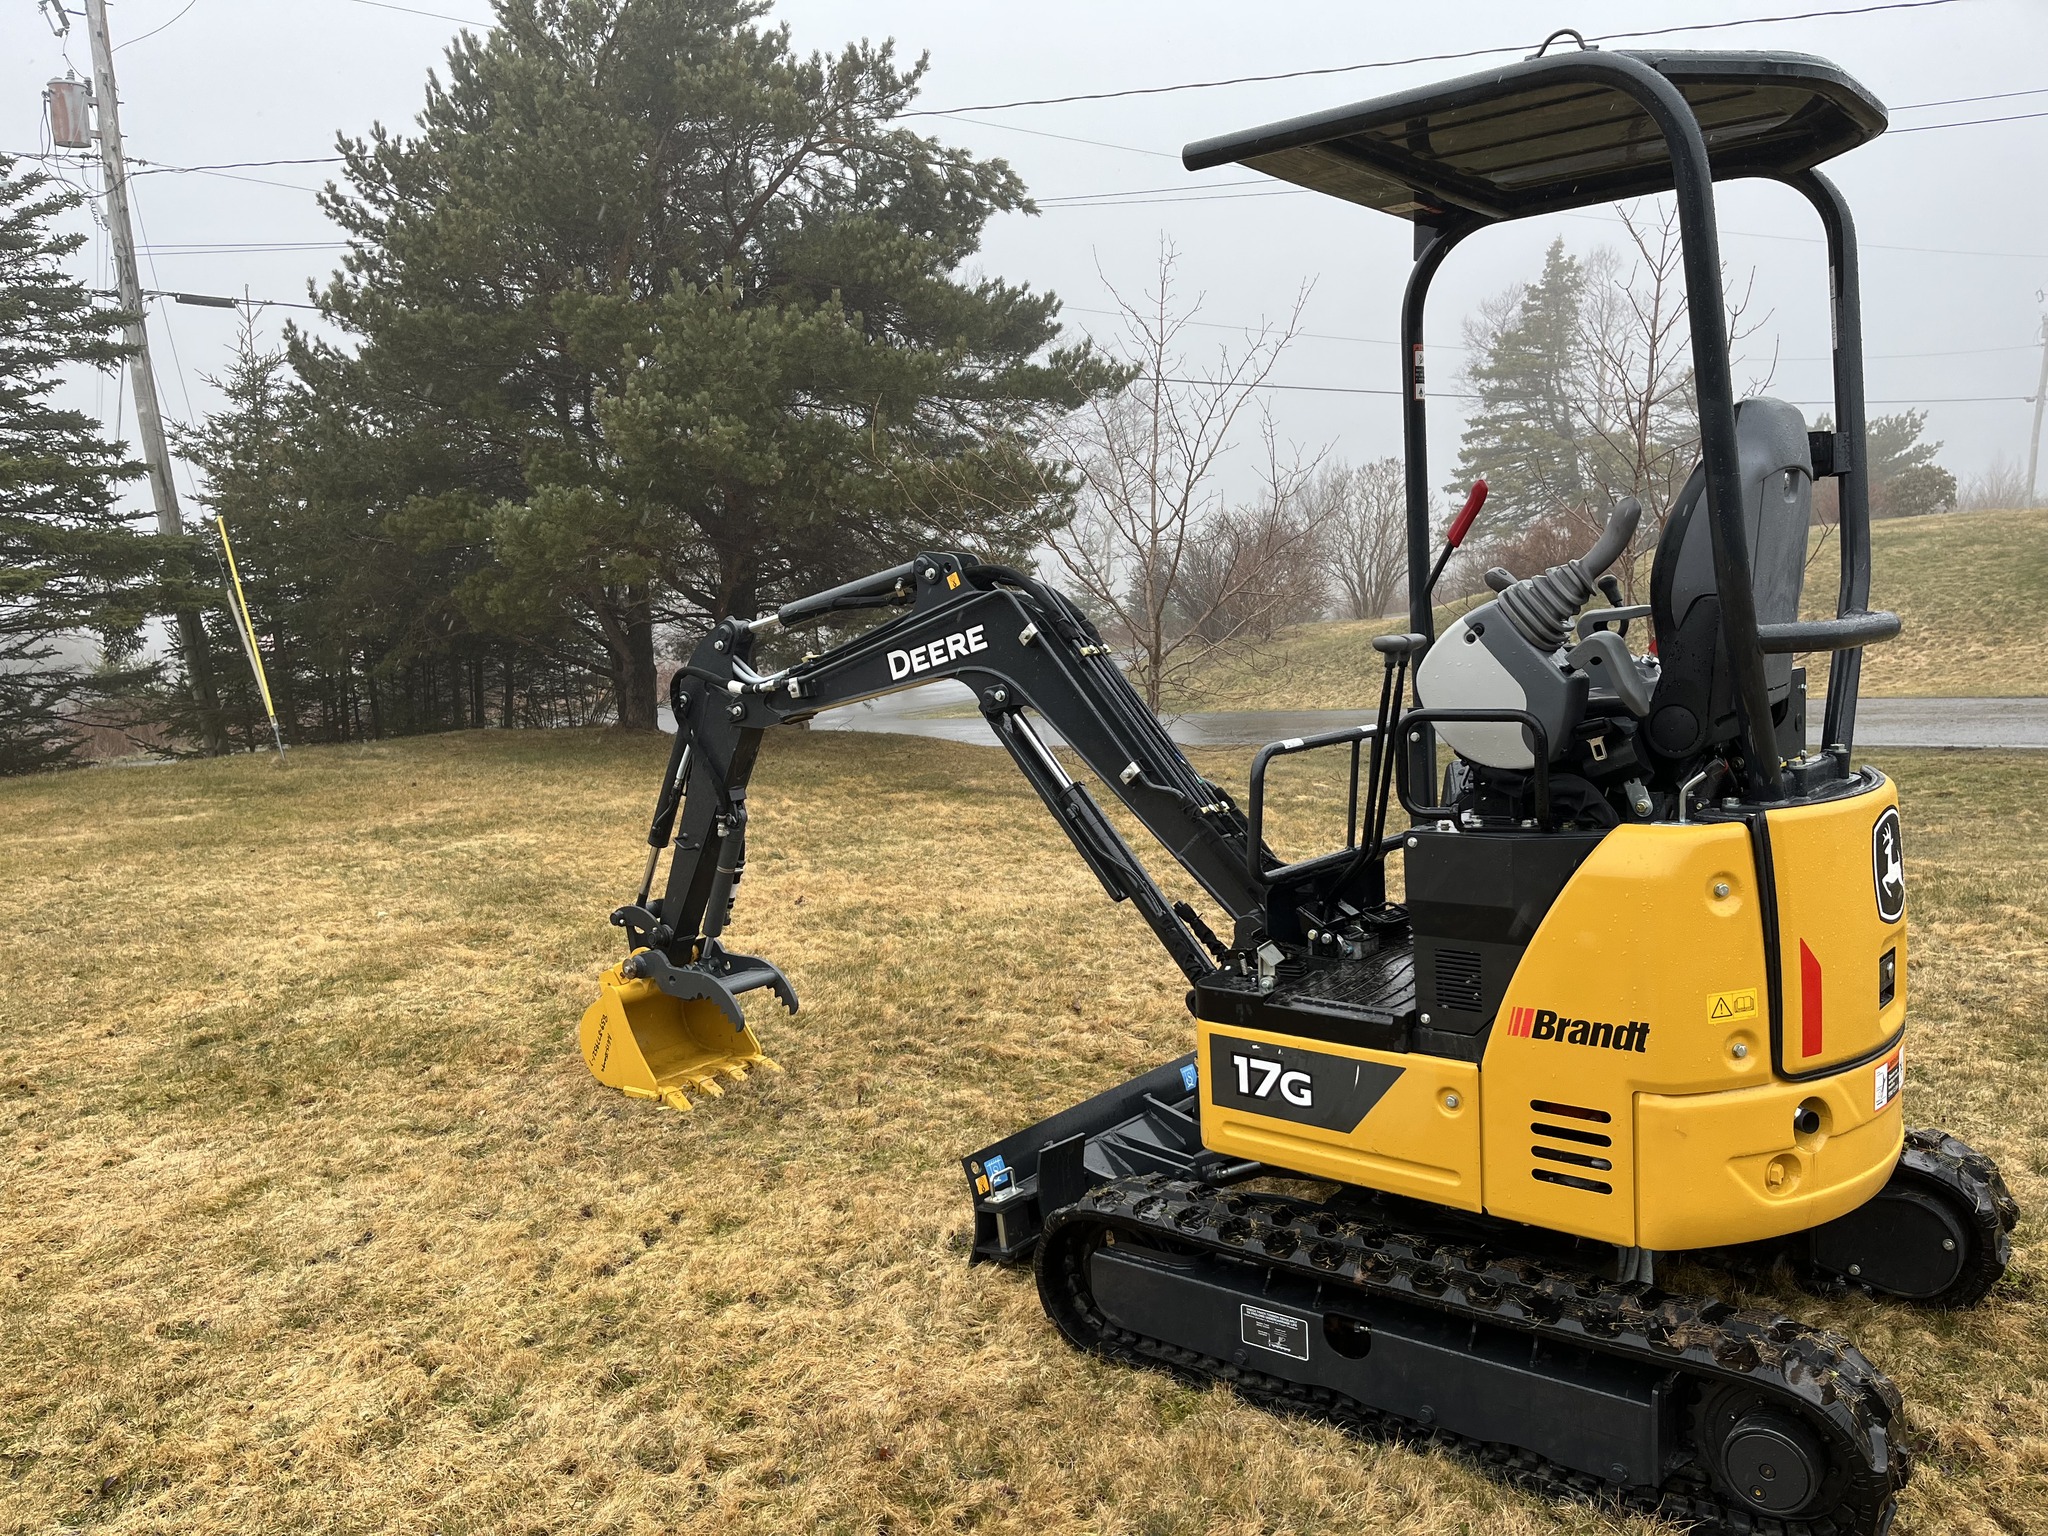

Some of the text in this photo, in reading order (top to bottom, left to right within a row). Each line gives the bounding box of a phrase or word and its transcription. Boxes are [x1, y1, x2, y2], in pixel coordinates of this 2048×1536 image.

[887, 624, 988, 680] DEERE
[1532, 1009, 1650, 1053] Brandt
[1233, 1055, 1312, 1107] 17G
